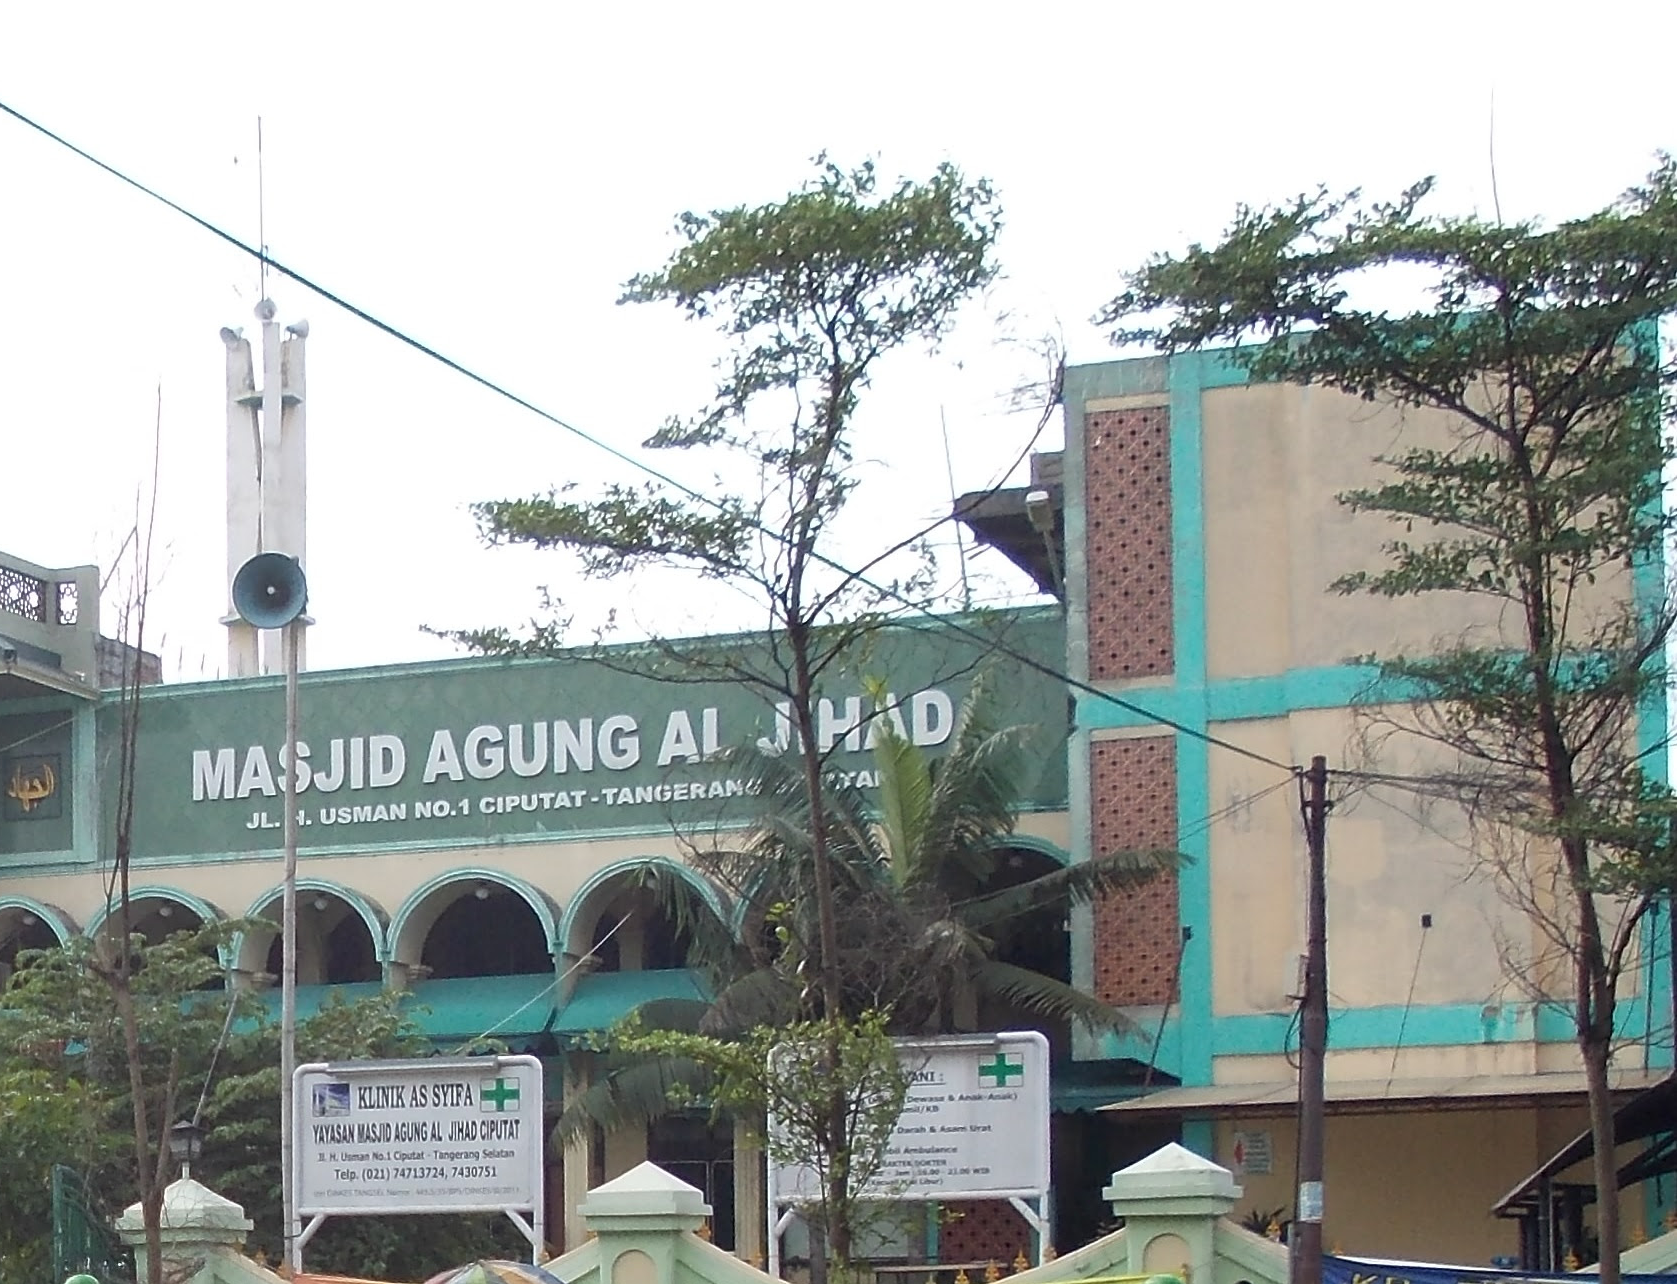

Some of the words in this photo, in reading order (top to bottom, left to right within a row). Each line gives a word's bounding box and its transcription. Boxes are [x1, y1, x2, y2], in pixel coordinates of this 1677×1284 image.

[192, 735, 405, 800] MASJID
[423, 714, 641, 783] AGUNG
[657, 708, 727, 766] AL
[756, 689, 954, 757] JHAD
[247, 813, 281, 829] JL.
[321, 804, 406, 825] USMAN
[415, 800, 469, 819] NO.1
[480, 790, 587, 814] CIPUTAT
[358, 1086, 405, 1110] KLINIK
[409, 1084, 427, 1108] AS
[432, 1083, 474, 1107] SYIFA
[313, 1123, 355, 1144] YAYASAN
[357, 1122, 391, 1143] MASJID
[394, 1121, 428, 1143] AGUNG
[430, 1120, 442, 1142] AL
[448, 1120, 477, 1142] JIHAD
[480, 1119, 520, 1141] CIPUTAT
[341, 1151, 369, 1162] Usman
[373, 1150, 391, 1162] No.1
[394, 1150, 424, 1162] Ciputat
[433, 1149, 480, 1162] Tangerang
[483, 1148, 514, 1159] Selatan
[334, 1168, 359, 1182] Telp.
[362, 1168, 390, 1182] (021)
[452, 1166, 497, 1178] 7430751
